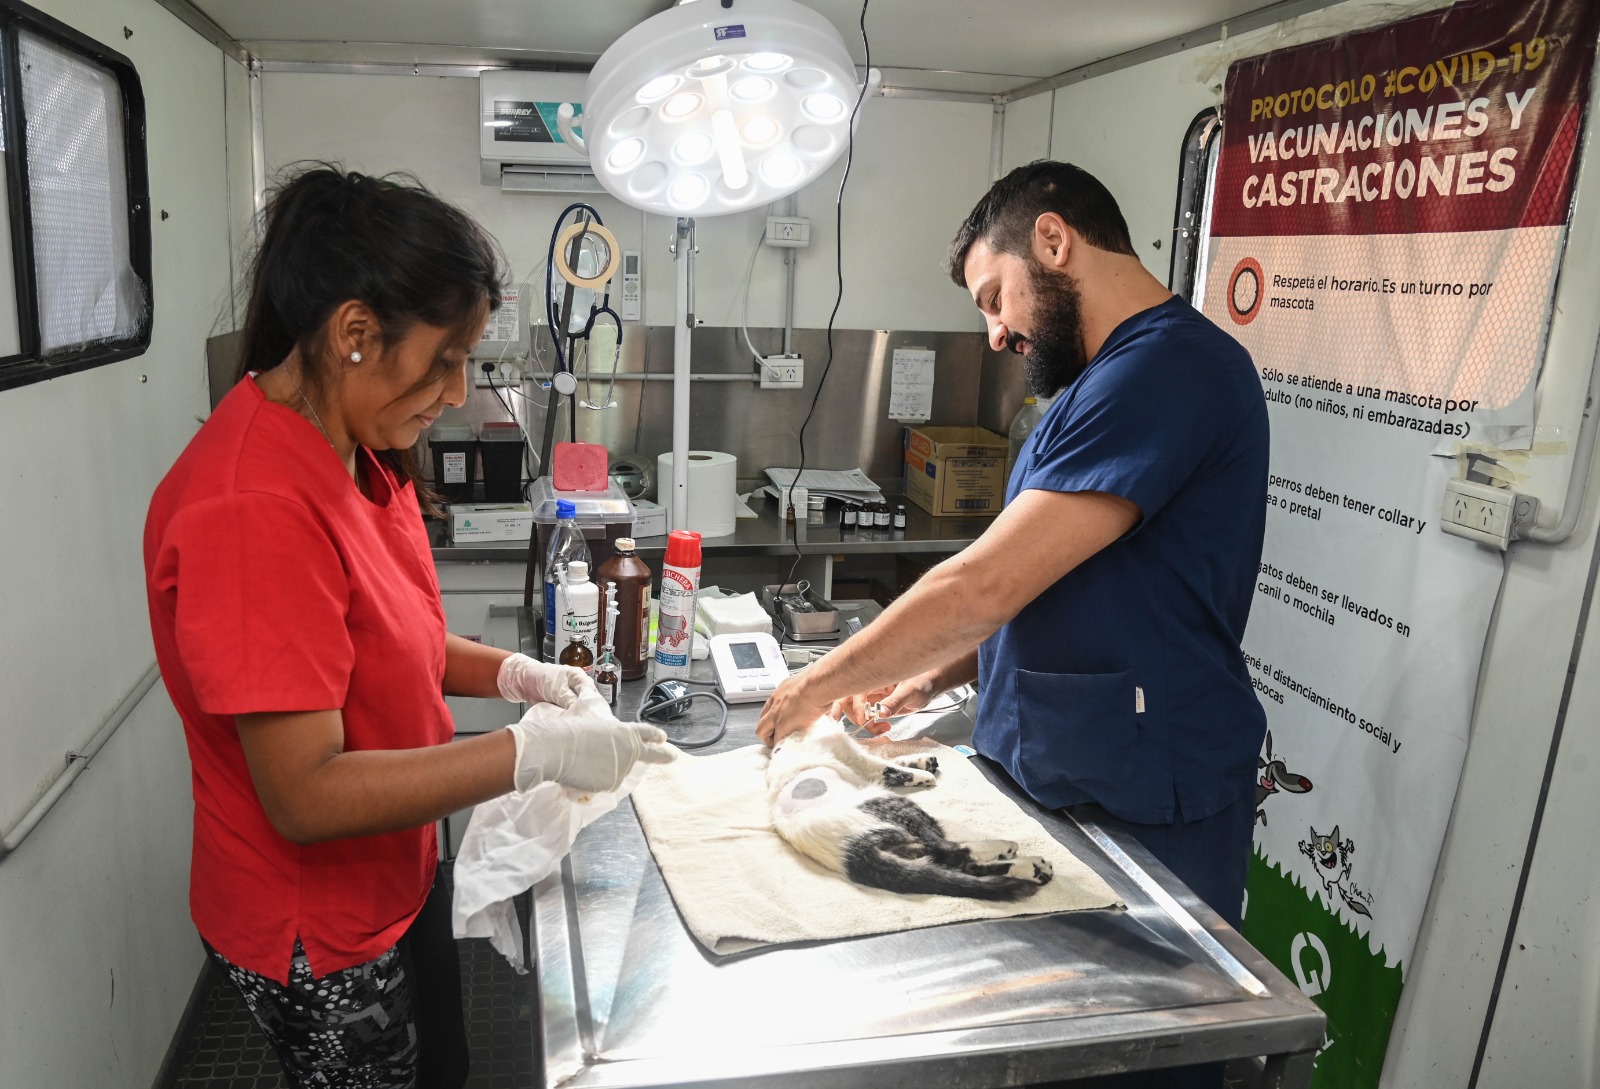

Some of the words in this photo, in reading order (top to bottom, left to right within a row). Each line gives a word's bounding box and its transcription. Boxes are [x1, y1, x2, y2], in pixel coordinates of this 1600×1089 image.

[1250, 75, 1376, 122] PROTOCOLO
[1384, 36, 1546, 98] #COVID-19
[1248, 98, 1490, 164] VACUNACIONES
[1505, 88, 1536, 130] Y
[1242, 148, 1518, 208] CASTRACIONES
[1270, 296, 1314, 310] mascota
[1273, 274, 1315, 290] Respetá
[1317, 275, 1327, 289] el
[1401, 282, 1416, 295] un
[1419, 281, 1463, 296] turno
[1469, 282, 1492, 299] por
[1262, 368, 1284, 383] Sólo
[1287, 373, 1298, 386] se
[1301, 374, 1342, 395] atiende
[1346, 384, 1353, 395] a
[1357, 385, 1380, 400] una
[1385, 388, 1442, 410] mascota
[1444, 398, 1478, 414] por
[1263, 388, 1292, 406] dulto
[1295, 394, 1312, 410] (no
[1316, 397, 1348, 420] niños,
[1352, 404, 1364, 420] ni
[1367, 409, 1471, 439] embarazadas)
[1269, 474, 1302, 494] perros
[1304, 484, 1339, 504] deben
[1343, 494, 1375, 516] tener
[1378, 508, 1413, 528] collar
[1417, 518, 1426, 534] y
[1280, 499, 1287, 509] o
[1290, 502, 1321, 520] pretal
[661, 588, 693, 596] ATA
[1258, 581, 1282, 600] canil
[1283, 594, 1290, 604] o
[1292, 596, 1335, 626] mochila
[1286, 572, 1318, 597] deben
[1322, 590, 1340, 606] ser
[1341, 594, 1393, 629] llevados
[1396, 622, 1410, 638] en
[1251, 677, 1284, 704] abocas
[1263, 664, 1272, 676] el
[1273, 668, 1356, 724] distanciamiento
[1359, 717, 1392, 746] social
[1394, 738, 1402, 753] y
